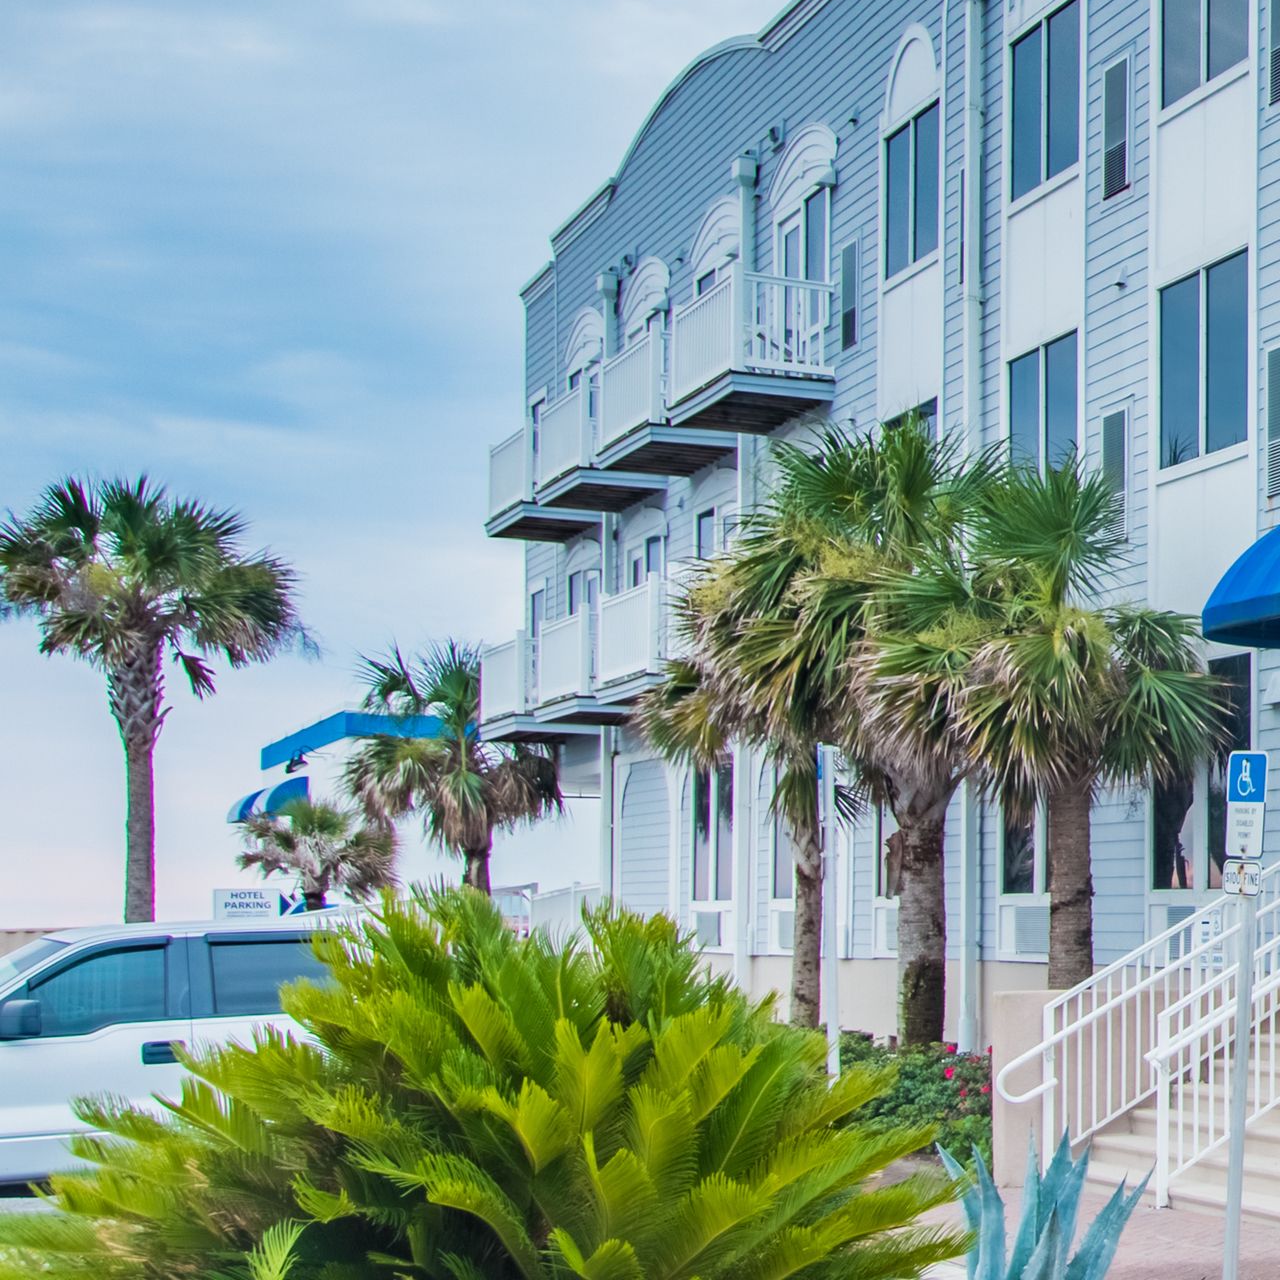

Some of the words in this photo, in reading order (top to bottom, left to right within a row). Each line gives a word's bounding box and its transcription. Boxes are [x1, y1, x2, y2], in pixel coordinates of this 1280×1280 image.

[1243, 872, 1259, 887] FINE
[230, 891, 265, 899] HOTEL
[224, 901, 271, 910] PARKING
